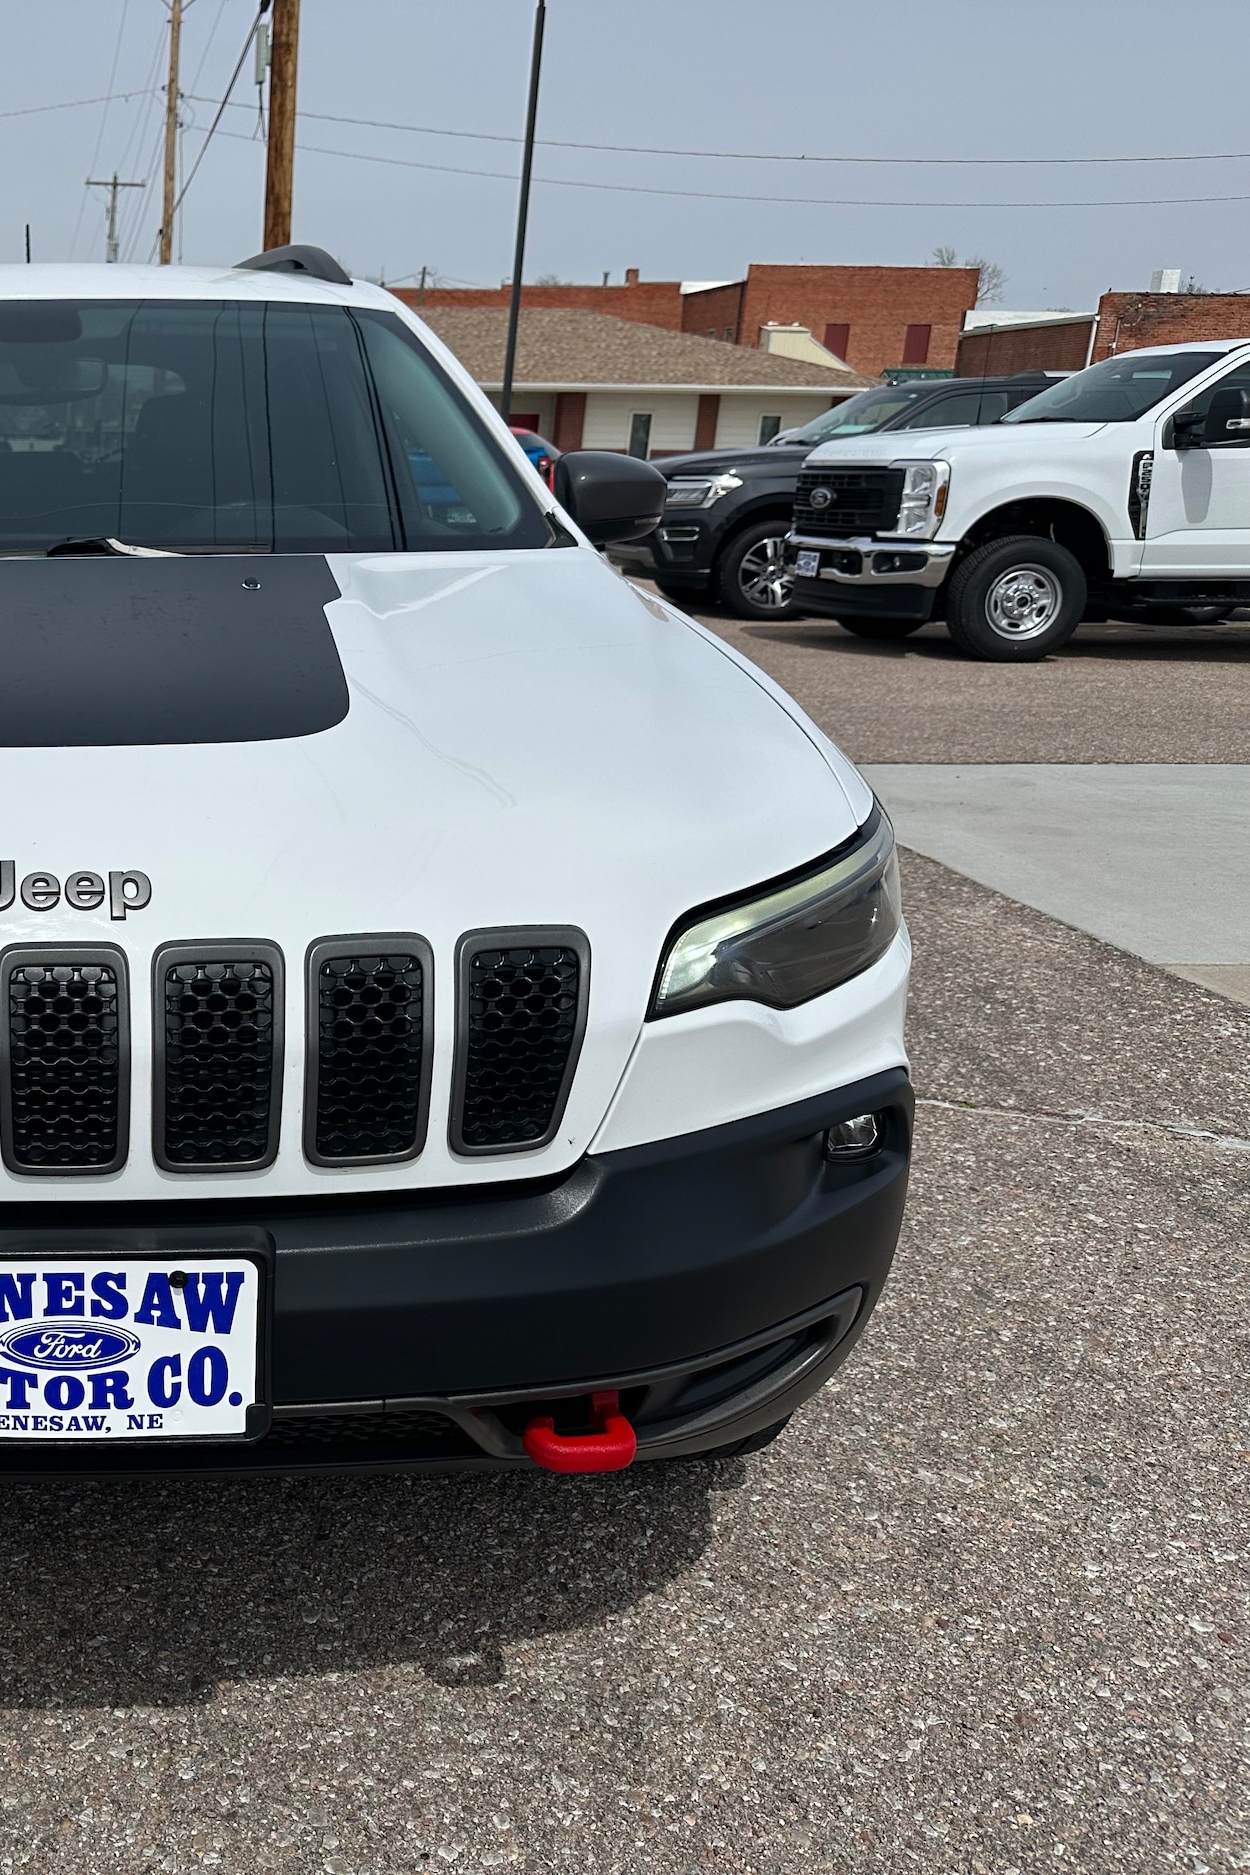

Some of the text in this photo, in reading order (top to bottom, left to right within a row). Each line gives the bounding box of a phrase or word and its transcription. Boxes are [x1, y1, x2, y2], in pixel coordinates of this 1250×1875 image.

[34, 1331, 103, 1359] Ford
[147, 1345, 243, 1408] CO.
[126, 1413, 163, 1430] NE
